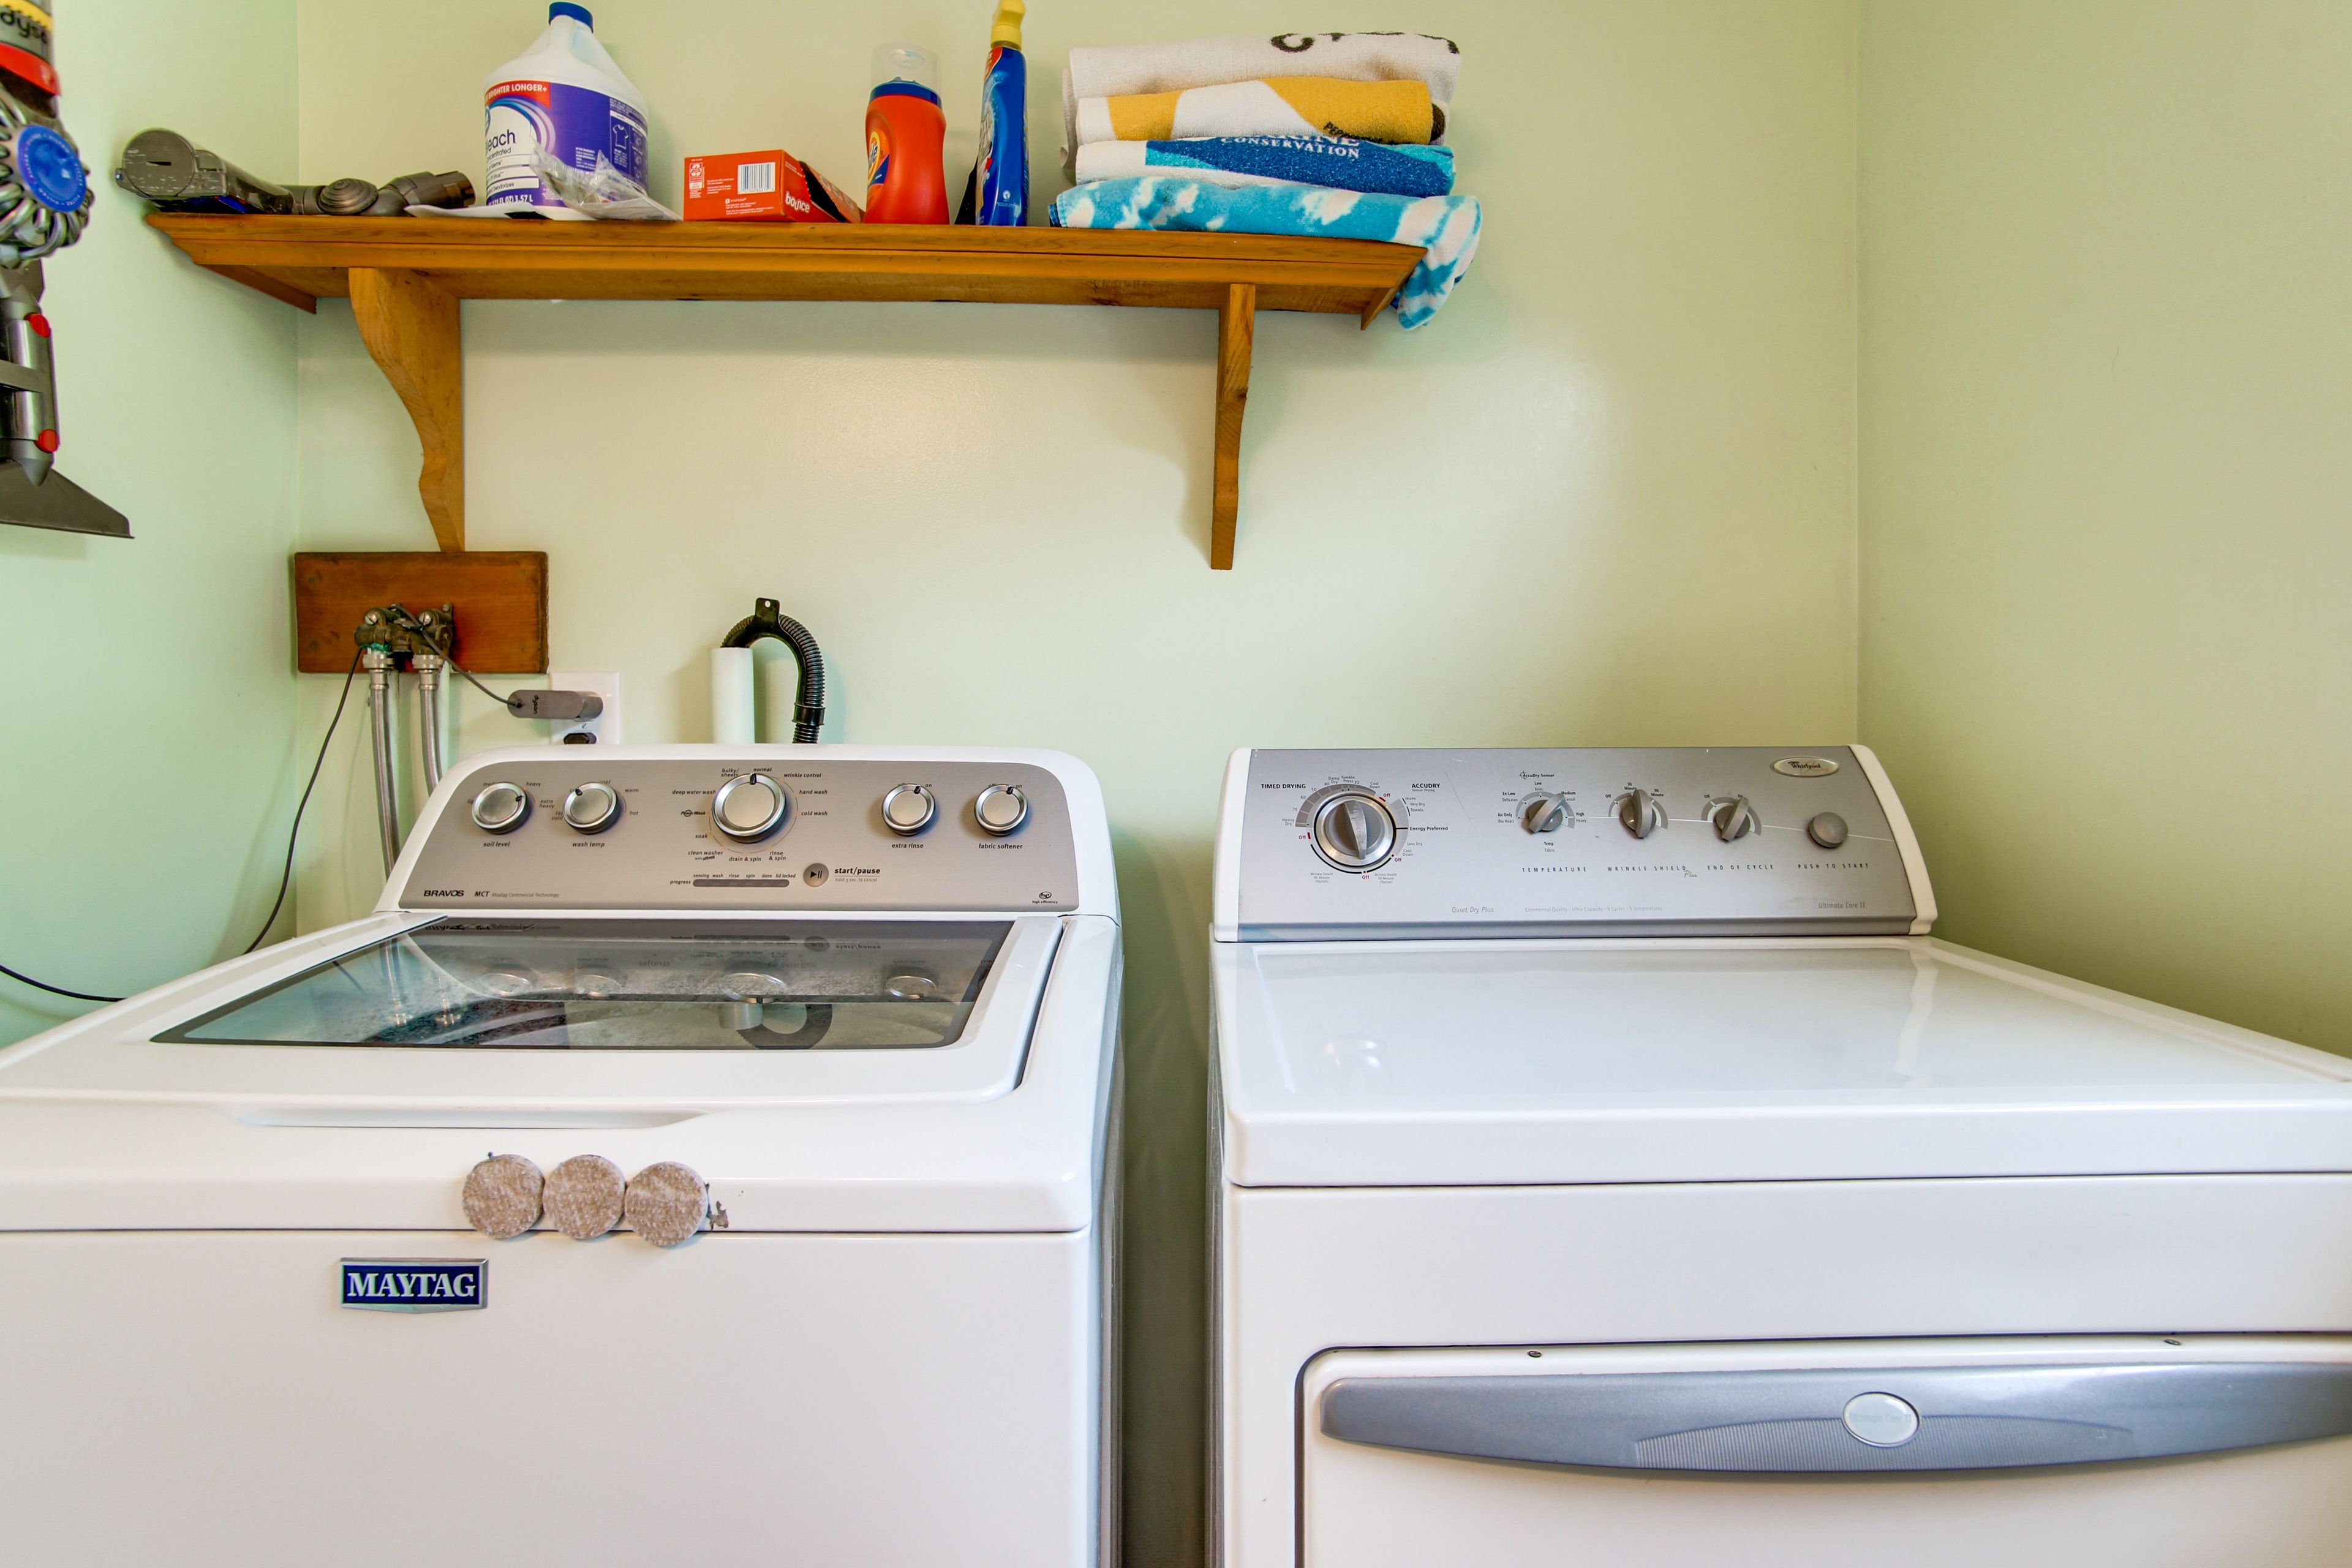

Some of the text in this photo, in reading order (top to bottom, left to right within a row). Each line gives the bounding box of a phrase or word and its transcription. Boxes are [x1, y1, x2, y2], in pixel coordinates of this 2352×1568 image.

[511, 83, 548, 92] LONGER+
[1221, 137, 1359, 159] CONSERVATION
[785, 190, 810, 213] bounce
[834, 867, 880, 876] start/pause
[347, 1273, 477, 1297] MAYTAG
